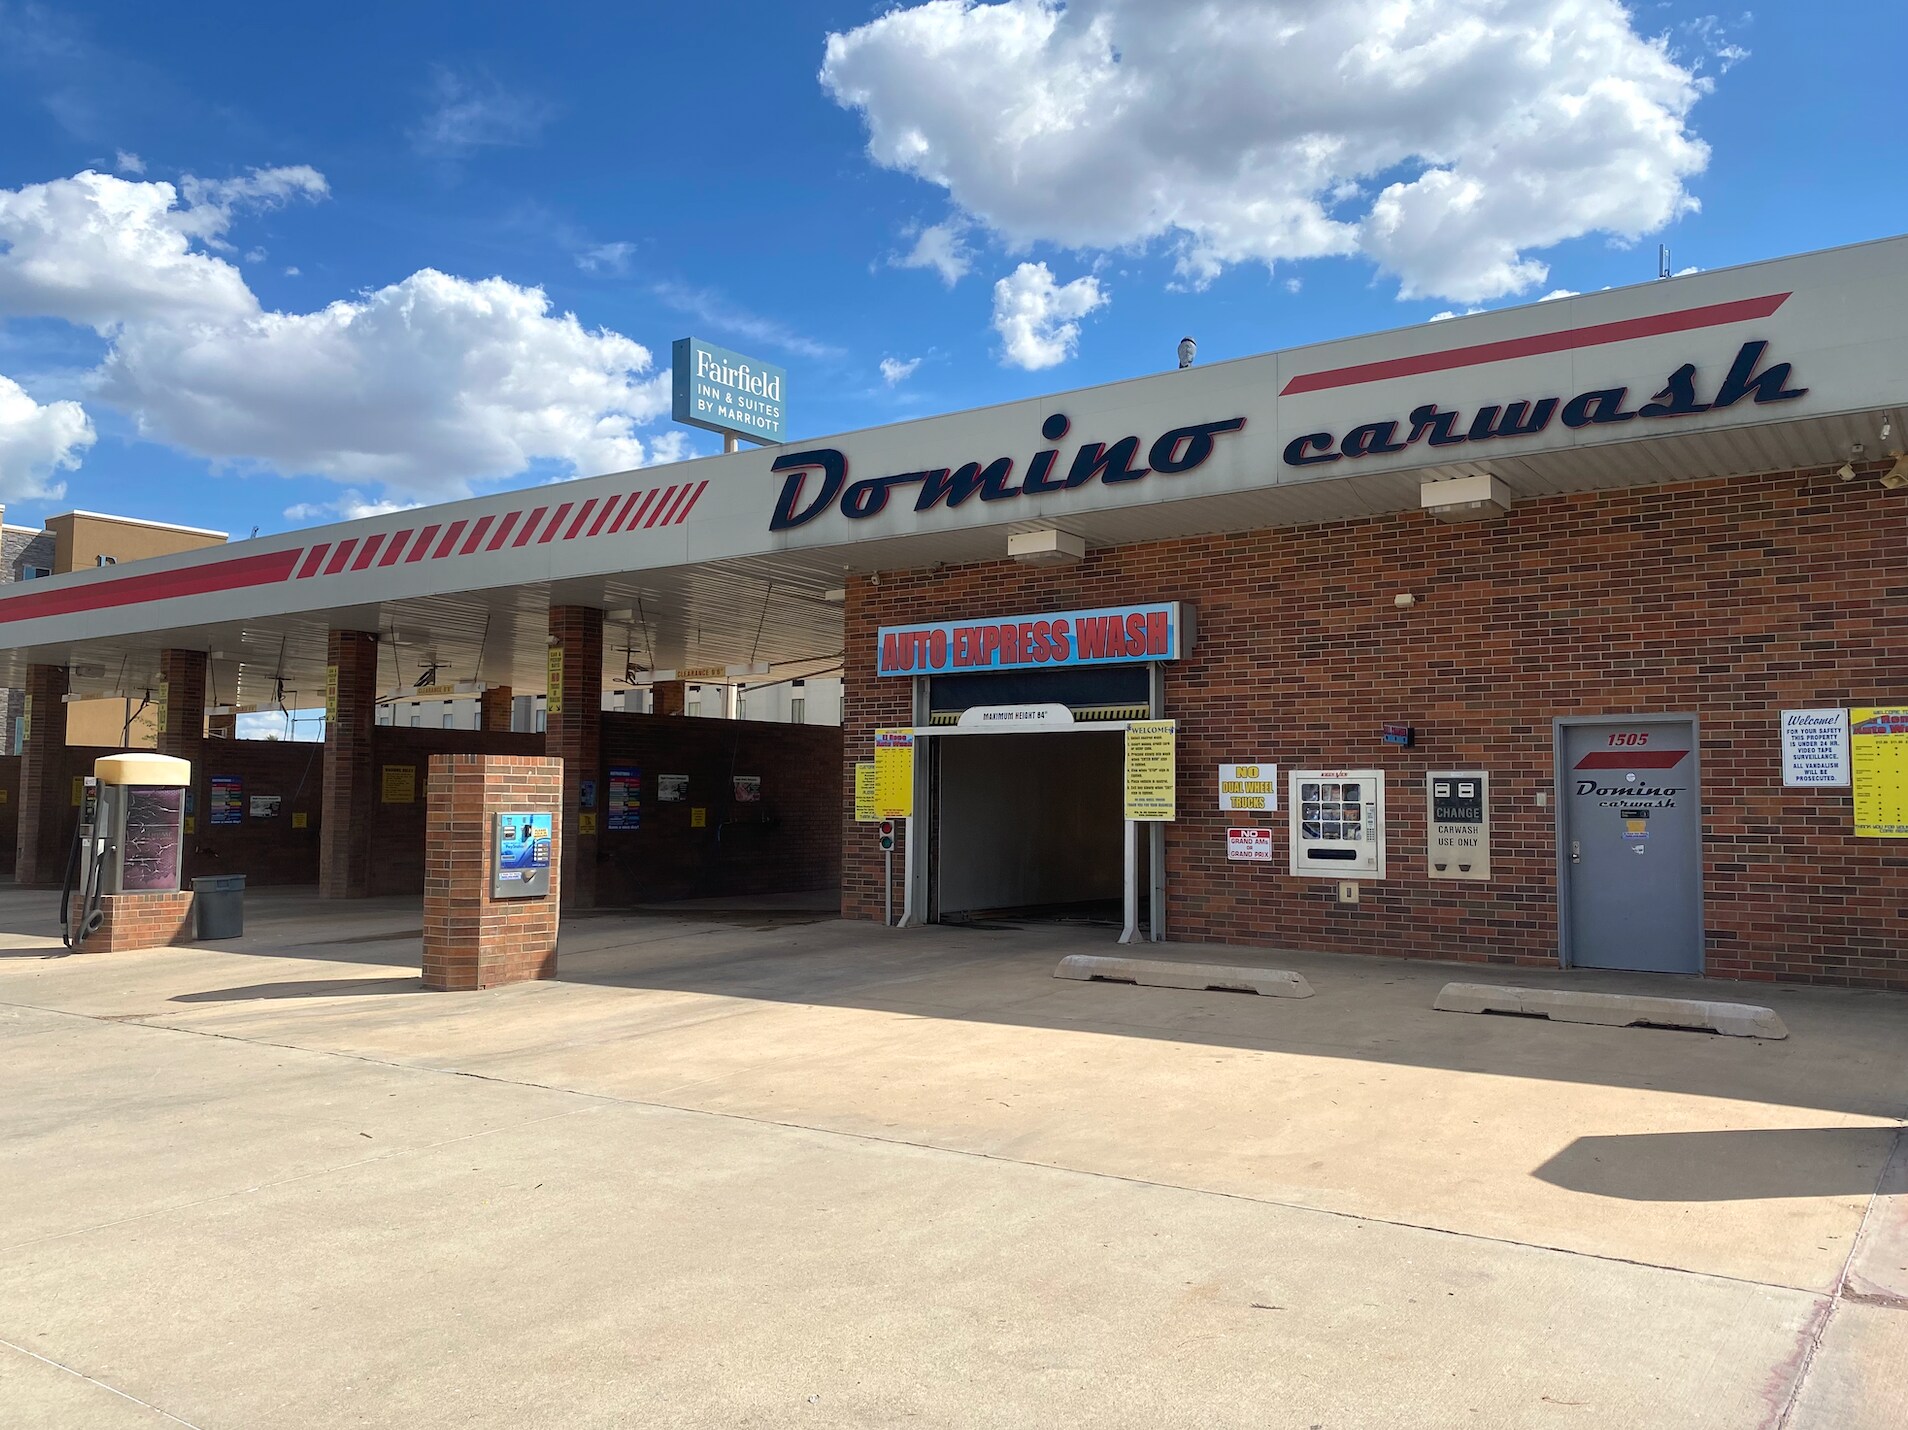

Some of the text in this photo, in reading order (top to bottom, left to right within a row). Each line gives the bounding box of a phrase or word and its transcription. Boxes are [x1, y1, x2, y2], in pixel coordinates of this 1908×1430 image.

[696, 349, 780, 402] Fairfield
[698, 383, 780, 418] INN & SUITES
[1283, 339, 1810, 467] carwash
[698, 399, 779, 432] BY MARRIOTT
[769, 413, 1247, 531] Domino
[881, 611, 1169, 672] AUTO EXPRESS WASH
[677, 669, 709, 678] CLEARANCE
[983, 712, 1014, 721] MAXIMUM
[1015, 711, 1036, 720] HEIGHT
[1788, 714, 1840, 726] Welcome!
[1608, 733, 1649, 746] 1505
[1236, 766, 1259, 778] NO
[1222, 781, 1274, 793] DUAL WHEEL
[1576, 781, 1687, 796] Domino
[1230, 796, 1265, 809] TRUCKS
[1599, 799, 1677, 808] carwash
[1437, 807, 1480, 818] CHANGE
[1240, 830, 1259, 838] NO
[1438, 825, 1478, 834] CARWASH
[1438, 837, 1478, 847] USE ONLY
